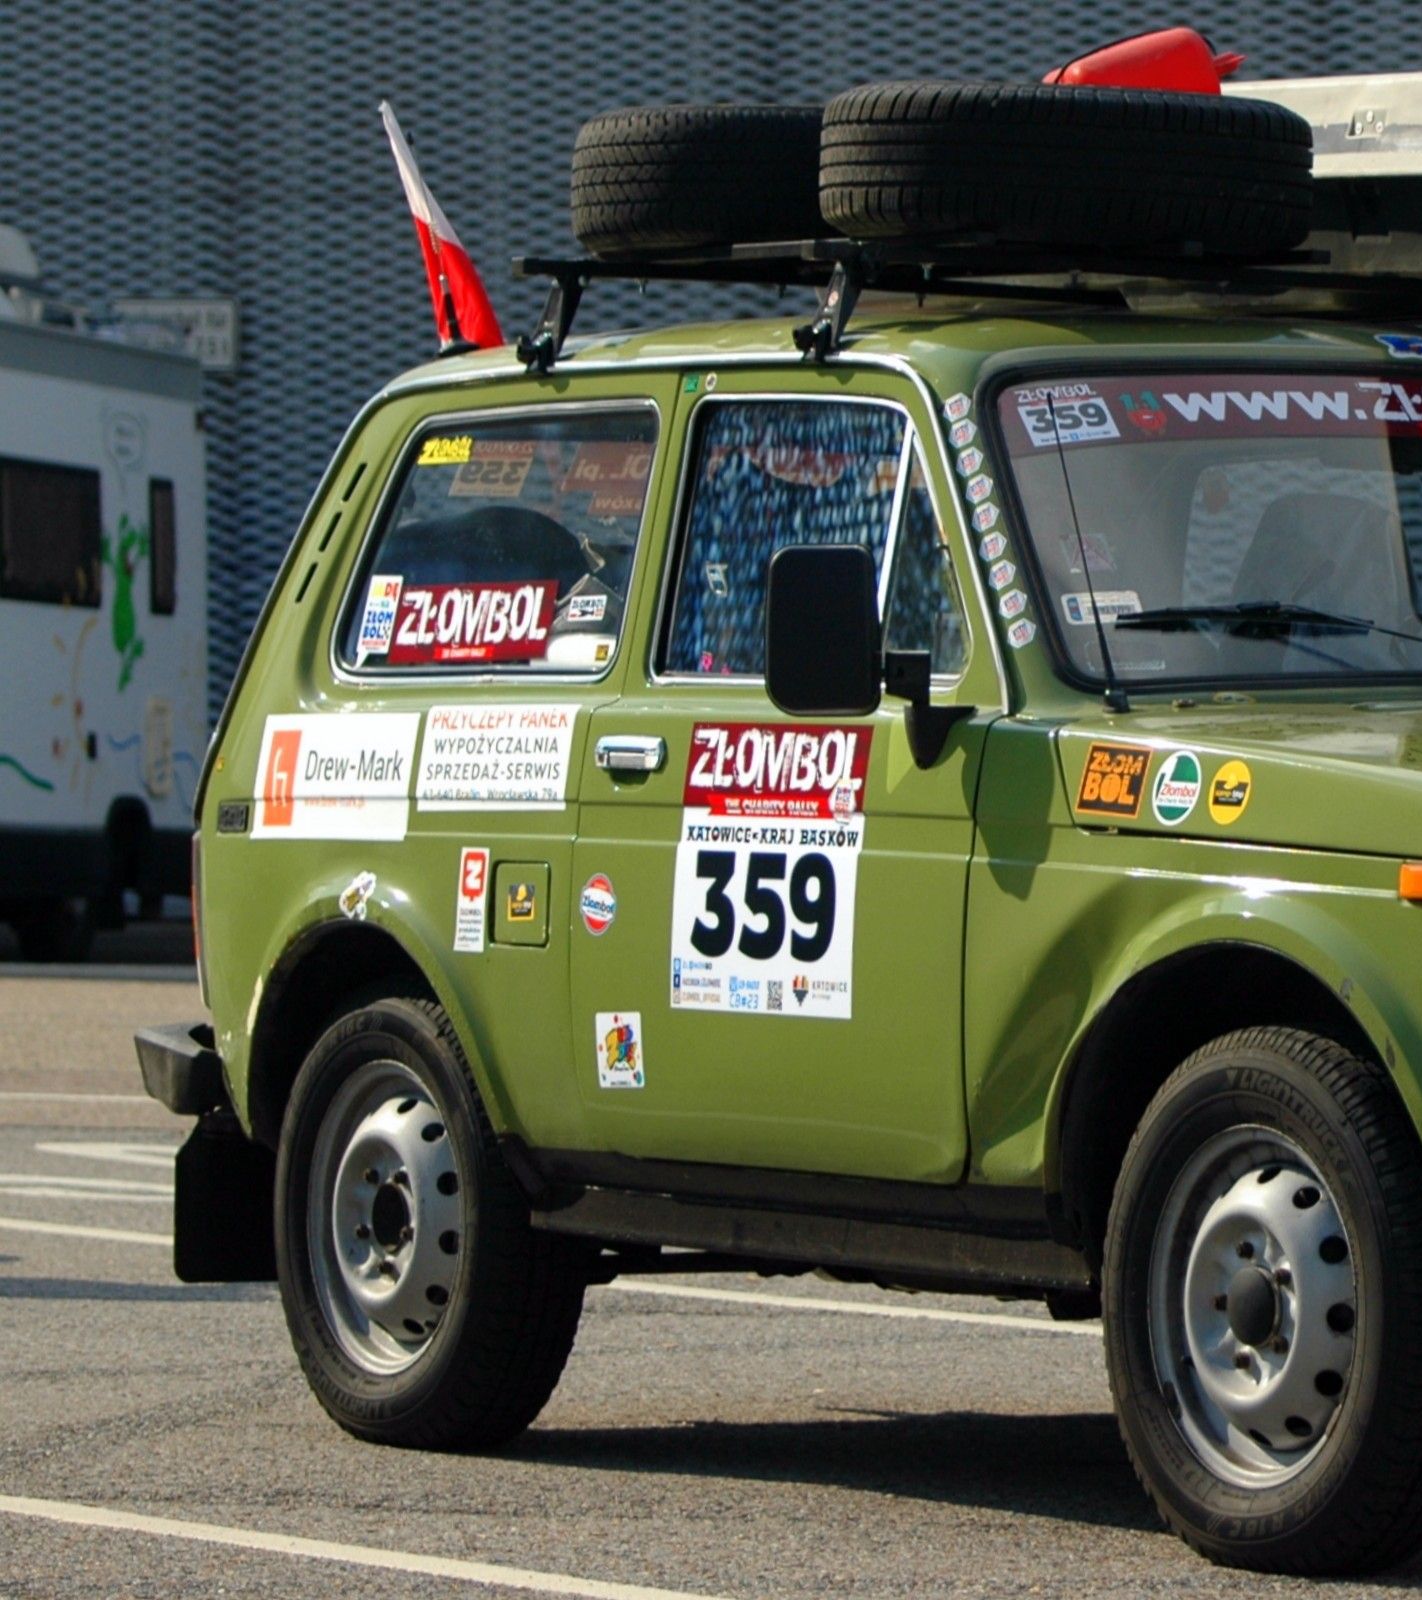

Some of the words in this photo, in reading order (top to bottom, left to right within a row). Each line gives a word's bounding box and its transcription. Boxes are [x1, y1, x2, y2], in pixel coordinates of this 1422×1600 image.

[1026, 402, 1108, 434] 359
[396, 585, 548, 646] ZŁOMBOL
[432, 710, 514, 730] PRZYCZEPY
[434, 733, 559, 755] WYPOŻYCZALNIA
[690, 727, 862, 792] ZŁOMBOL
[305, 749, 403, 781] Drew-Mark
[426, 759, 561, 780] SPRZEDAŻ-SERWIS
[1082, 771, 1136, 806] BOL
[799, 825, 859, 848] BASKÓW
[690, 849, 837, 963] 359
